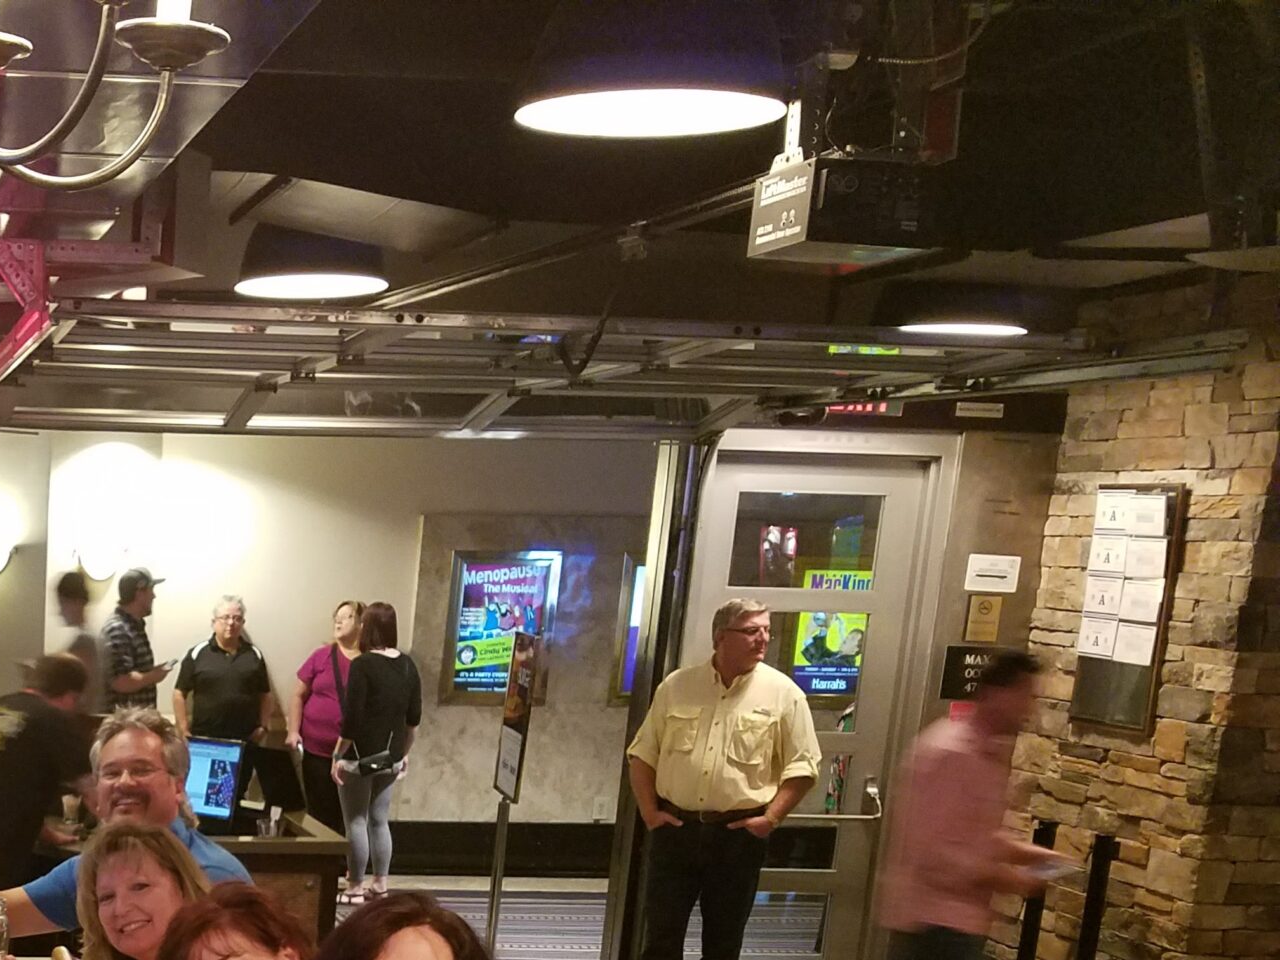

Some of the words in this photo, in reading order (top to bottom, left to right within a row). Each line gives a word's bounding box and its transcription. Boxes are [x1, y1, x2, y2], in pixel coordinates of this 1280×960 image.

[1109, 510, 1117, 521] A
[1104, 552, 1111, 563] A
[1098, 594, 1105, 605] A
[1092, 635, 1099, 646] A
